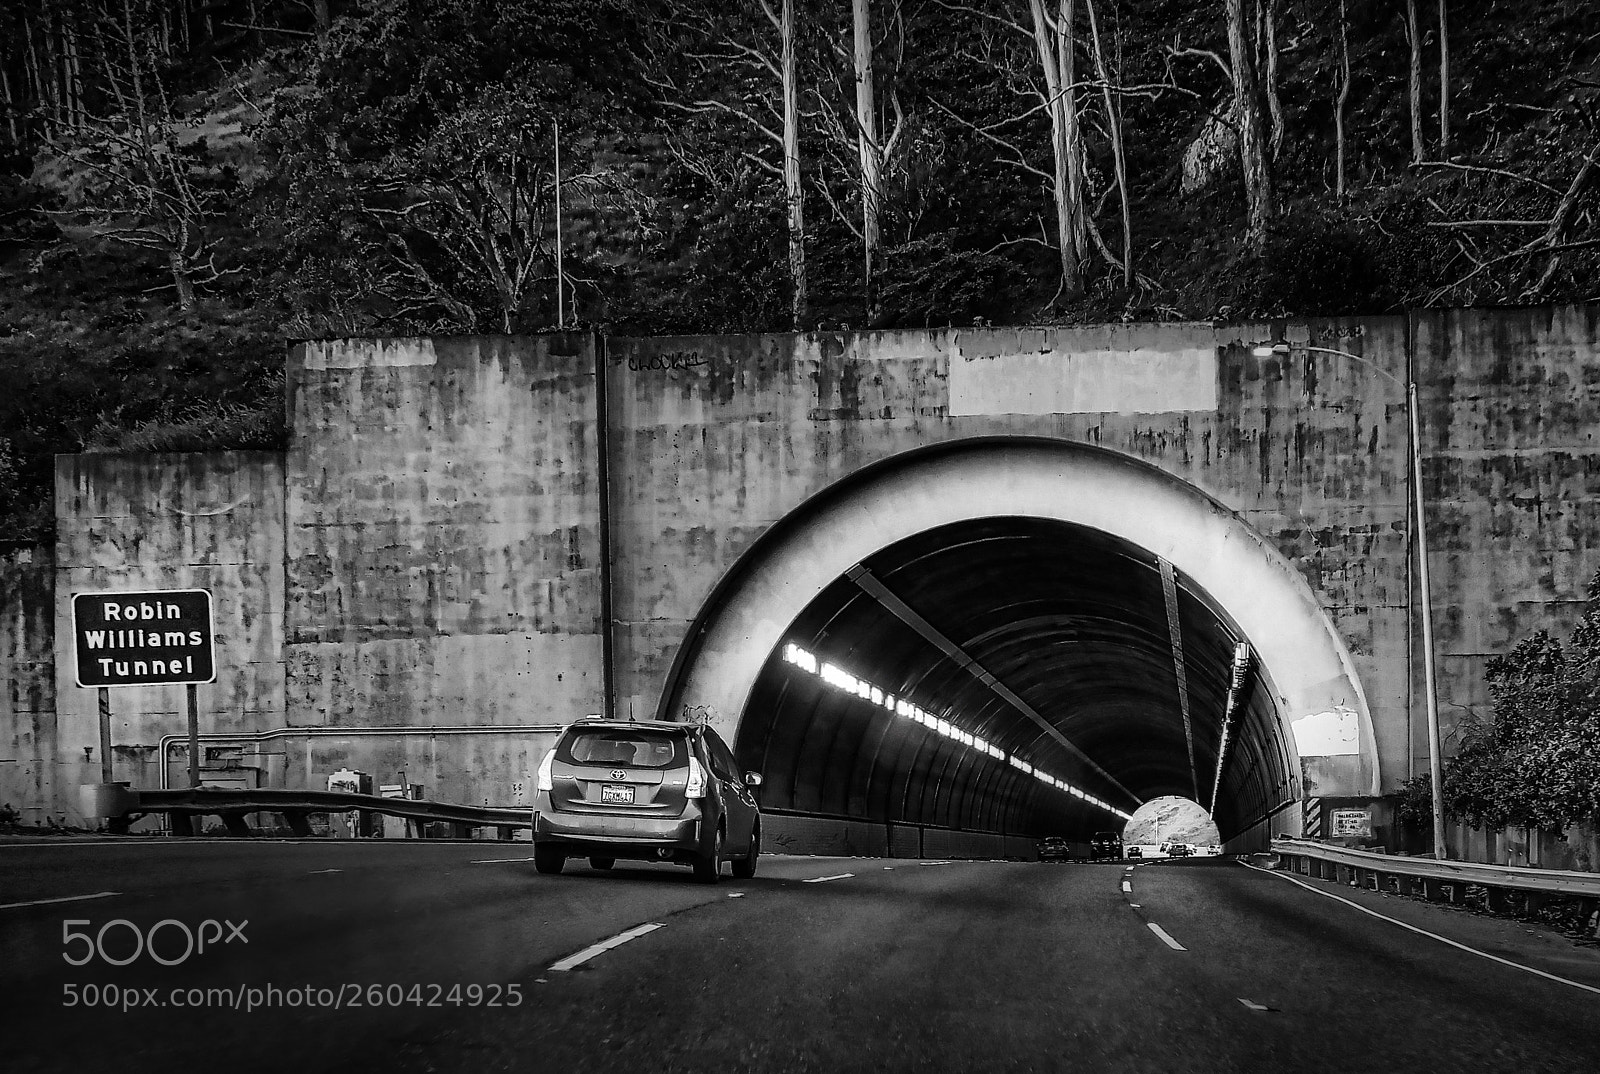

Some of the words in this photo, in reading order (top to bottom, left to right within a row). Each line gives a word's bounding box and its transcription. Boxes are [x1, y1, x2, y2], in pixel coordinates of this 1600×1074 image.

[103, 601, 181, 621] Robin
[84, 629, 203, 649] Williams
[97, 655, 193, 677] Tunnel
